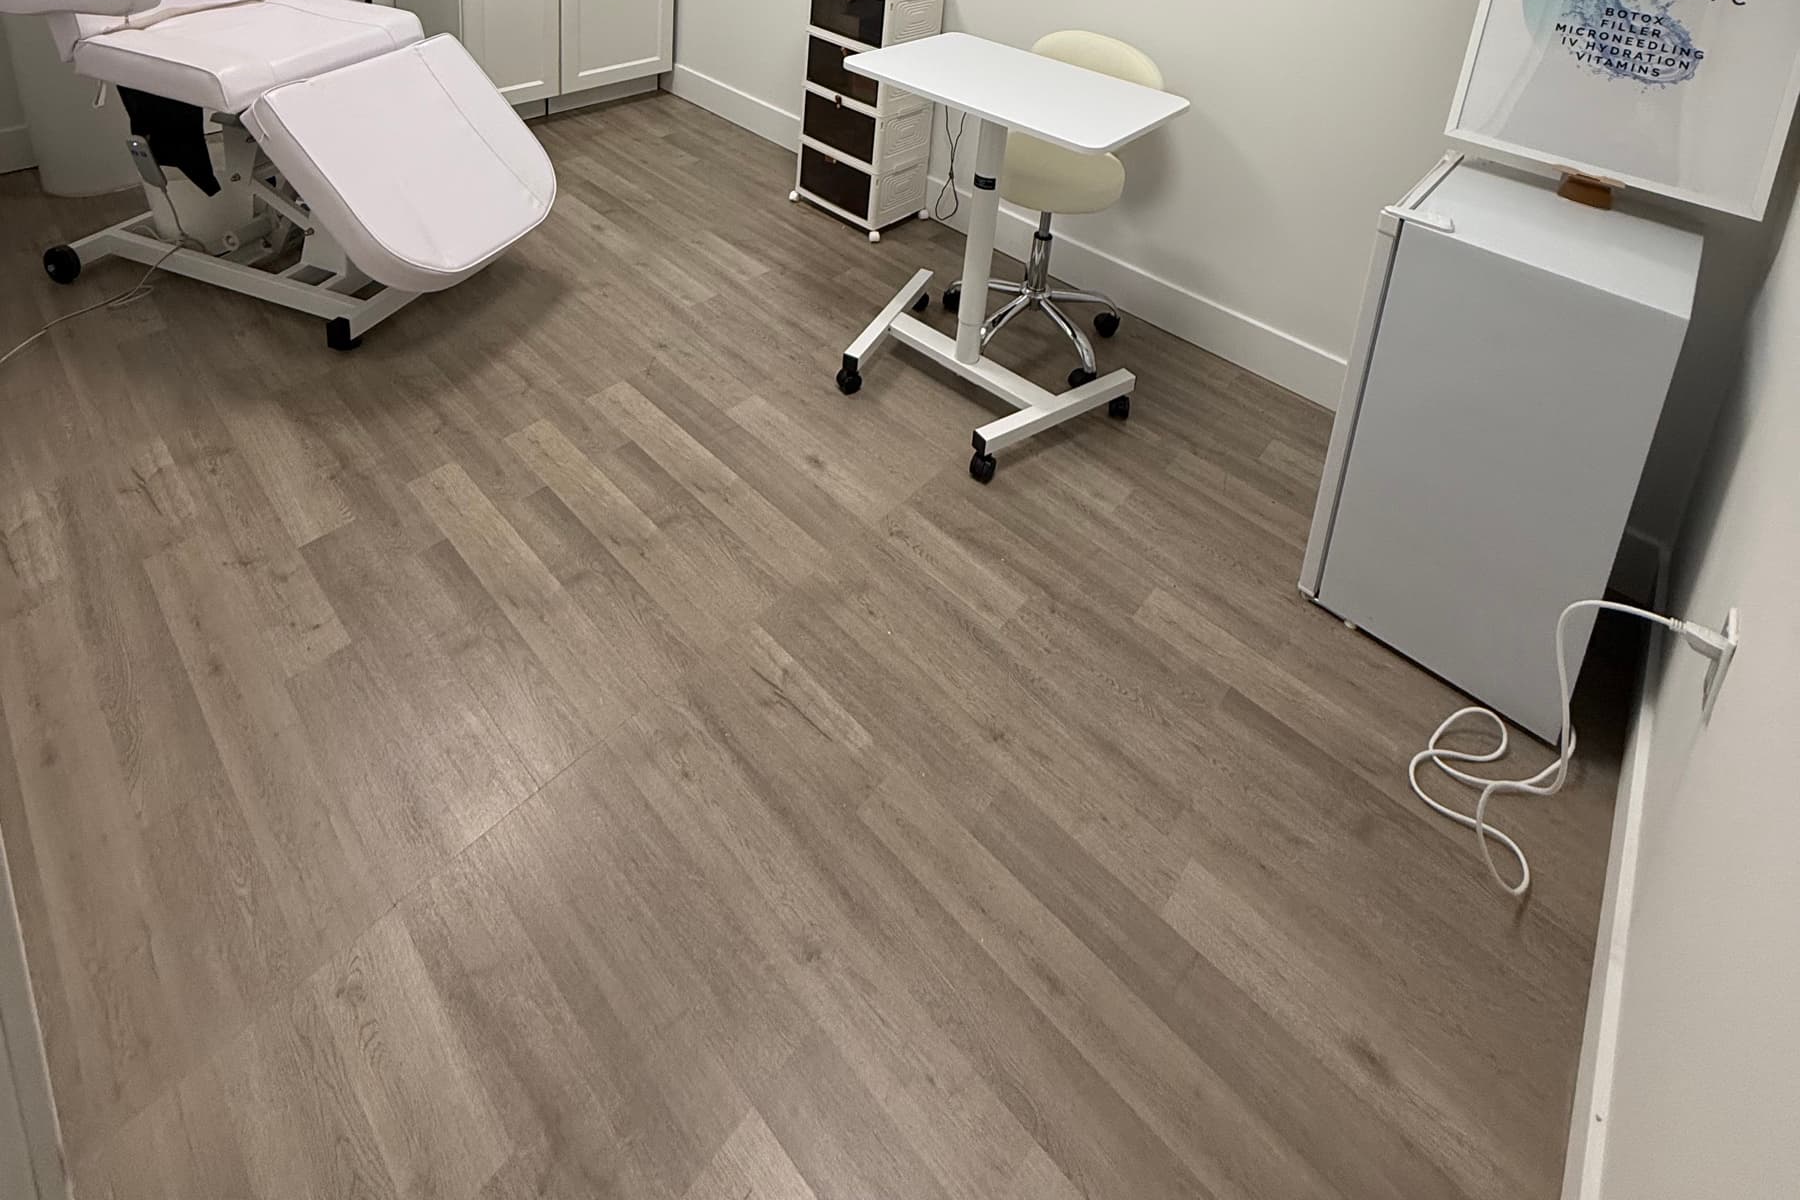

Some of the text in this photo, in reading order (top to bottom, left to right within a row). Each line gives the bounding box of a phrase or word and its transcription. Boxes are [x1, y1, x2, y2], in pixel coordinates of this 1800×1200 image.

[1601, 19, 1662, 39] FILLER
[1605, 7, 1664, 25] BOTOX
[1555, 23, 1705, 60] MICRONEEDLING
[1562, 36, 1690, 70] IV HYDRATION
[1576, 51, 1661, 77] VITAMINS
